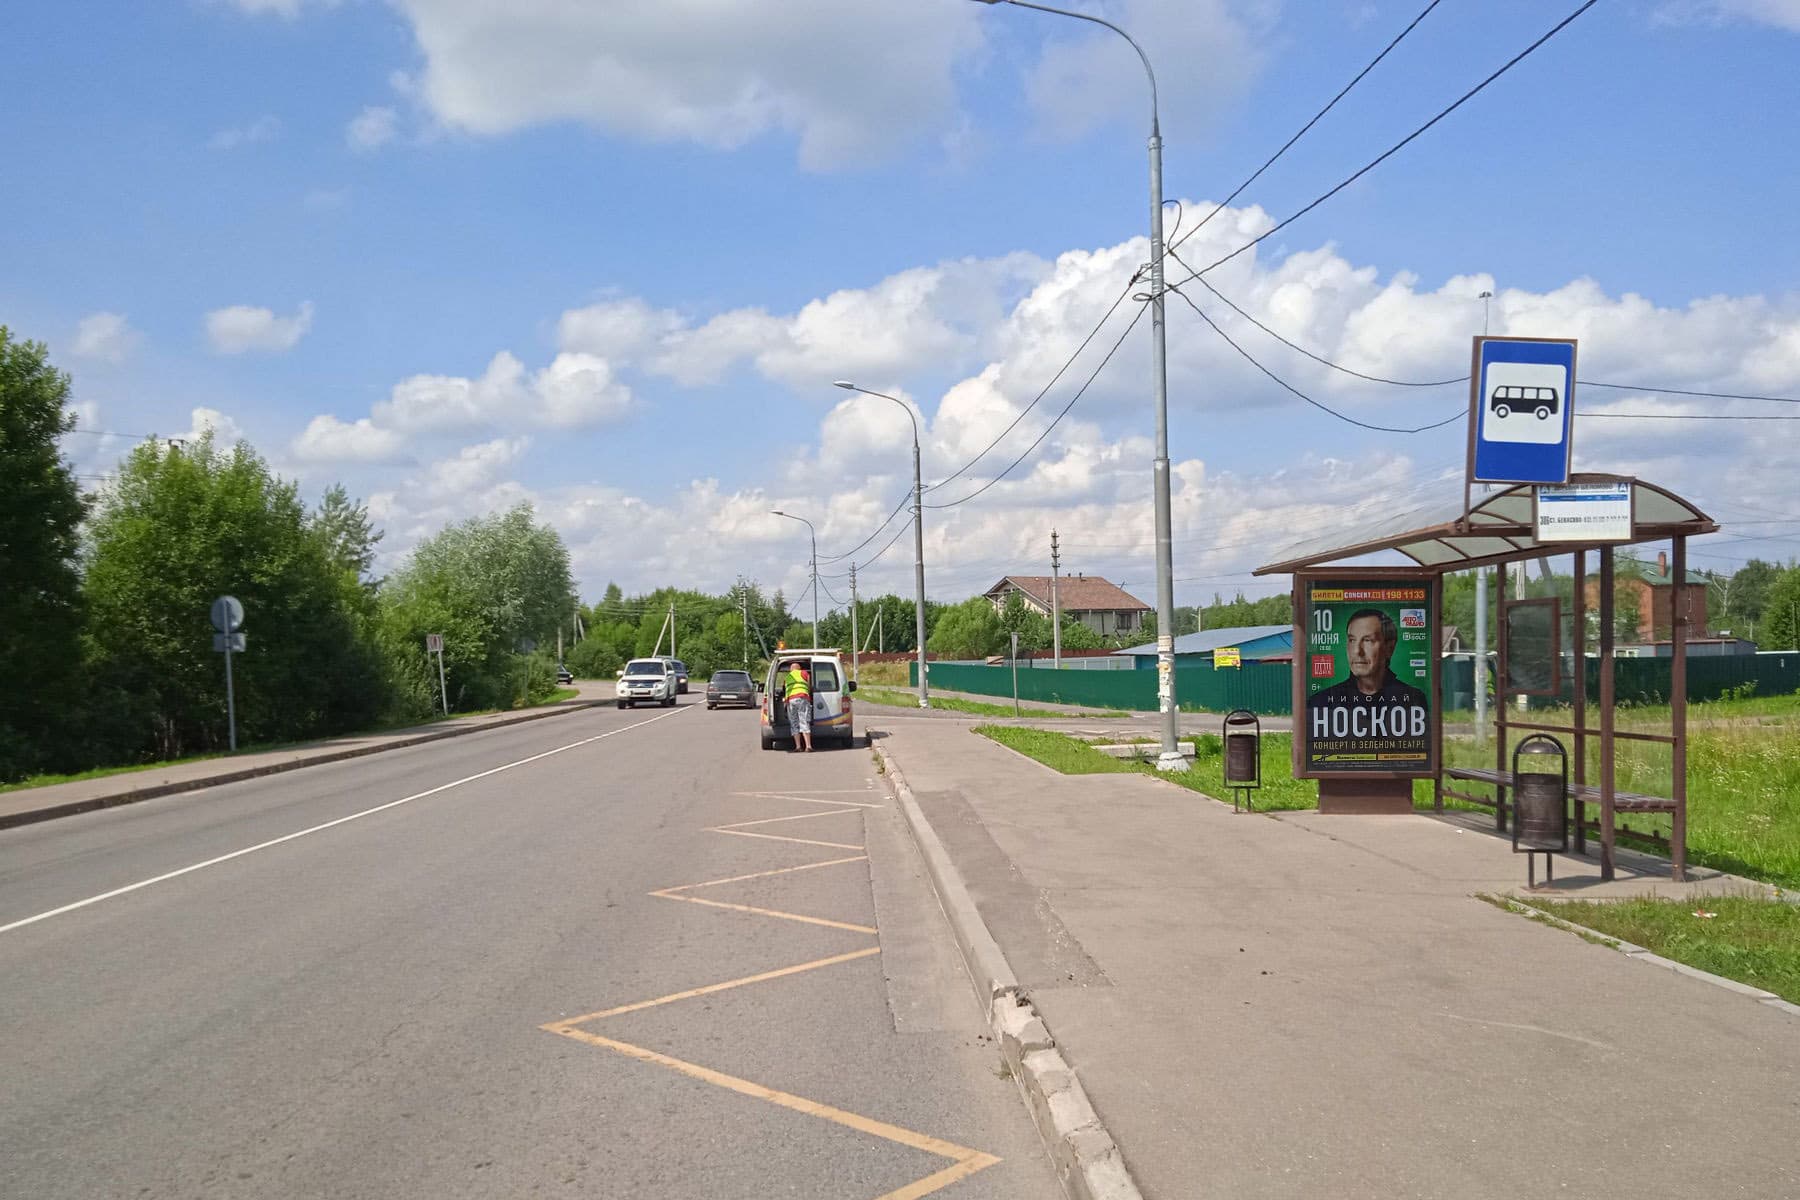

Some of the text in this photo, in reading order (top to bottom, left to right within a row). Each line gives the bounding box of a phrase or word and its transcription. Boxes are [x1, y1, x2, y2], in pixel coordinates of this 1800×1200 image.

[1404, 590, 1425, 599] 1133
[1313, 609, 1333, 632] 10
[1311, 632, 1339, 645] ИЮНЯ
[1311, 683, 1321, 691] 6+
[1328, 693, 1410, 703] НИКОЛАЙ
[1313, 705, 1426, 738] НОСКОВ
[1313, 739, 1425, 750] КОНЦЕРТ В ЗЕЛЕНОМ ТЕАТРЕ
